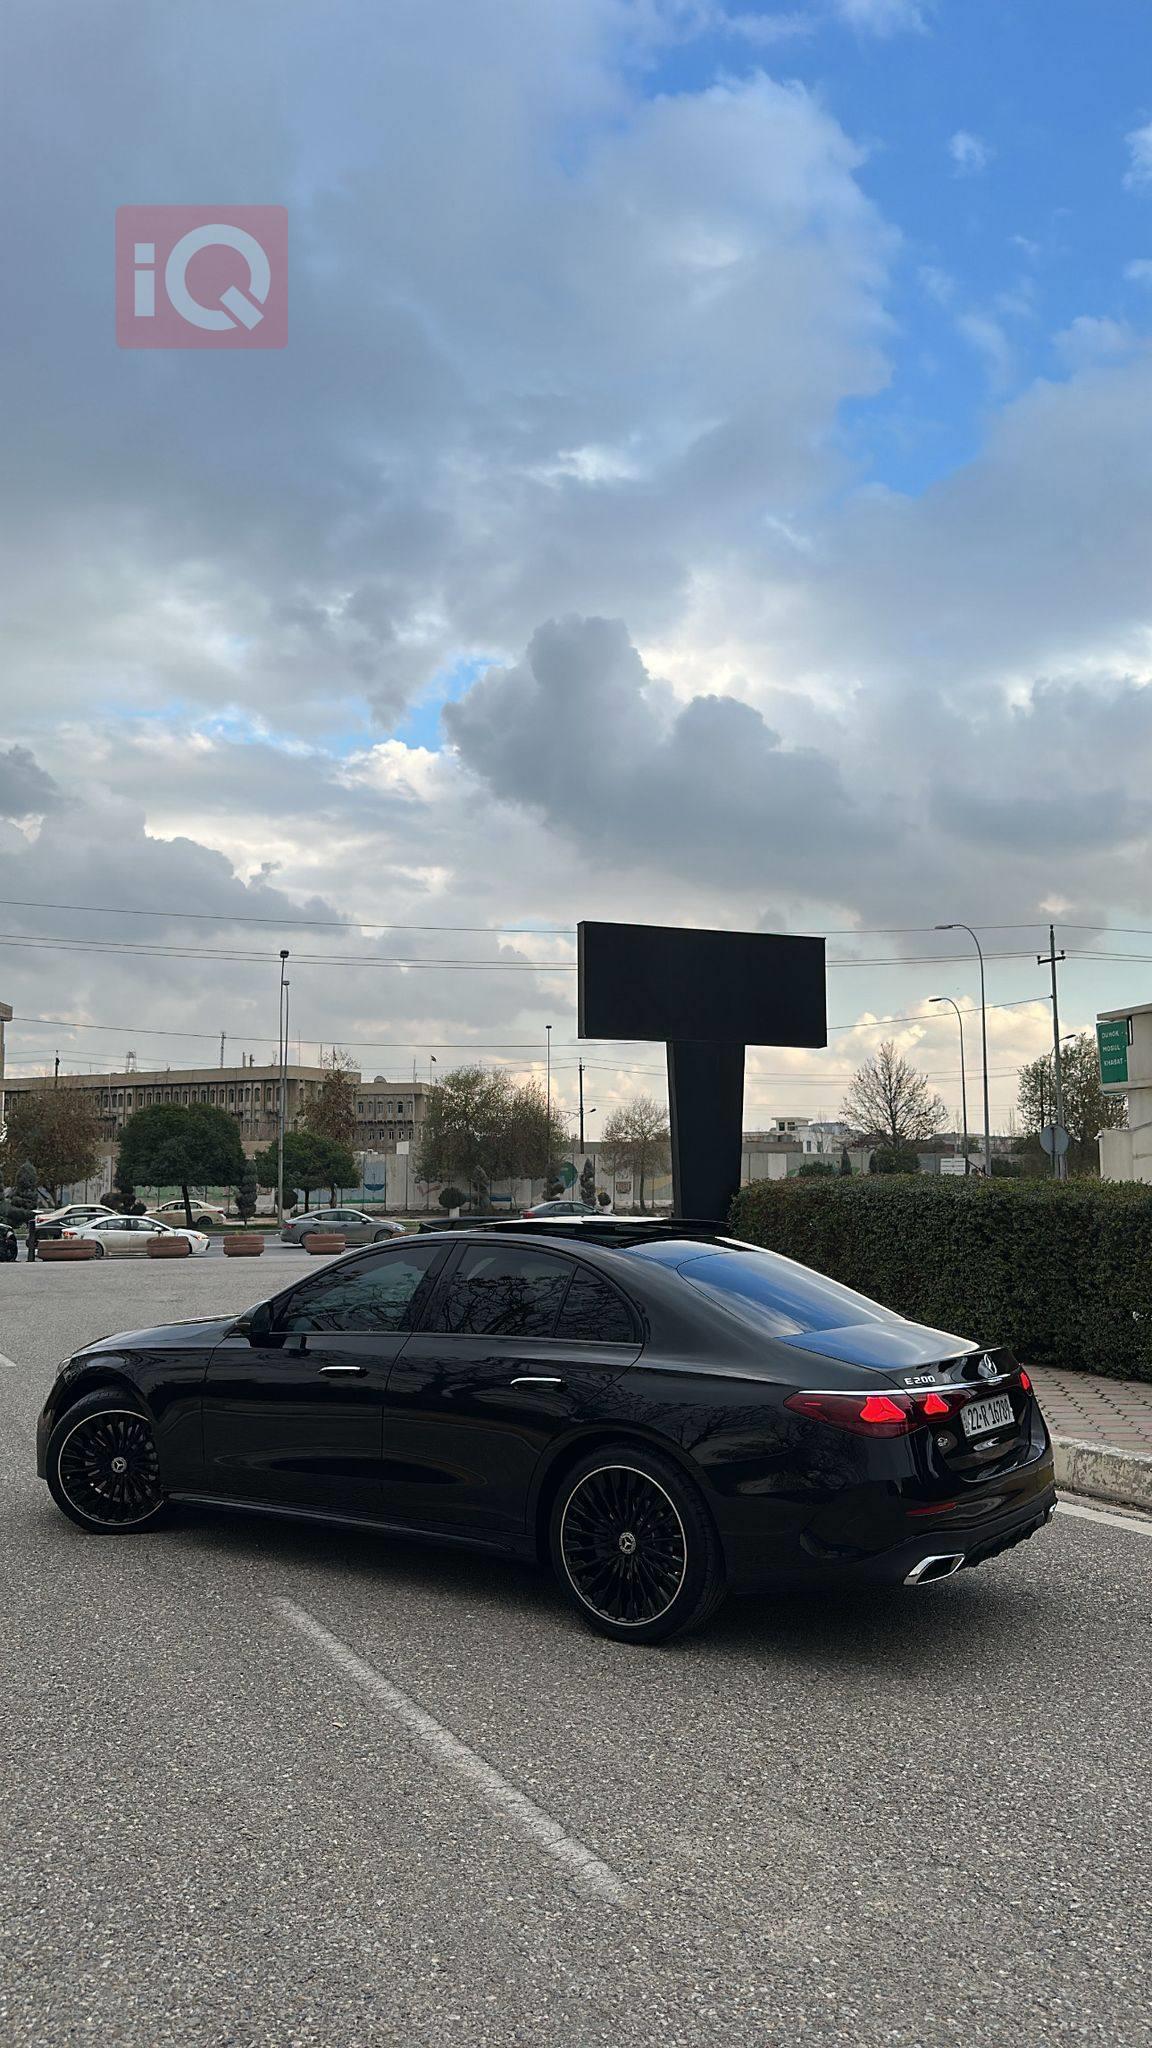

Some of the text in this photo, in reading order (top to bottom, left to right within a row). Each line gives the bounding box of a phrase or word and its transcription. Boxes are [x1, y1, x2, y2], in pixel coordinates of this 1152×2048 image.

[1101, 1030, 1119, 1039] DUHOK
[1102, 1044, 1120, 1052] MOSUL
[1103, 1057, 1123, 1066] KHABAT
